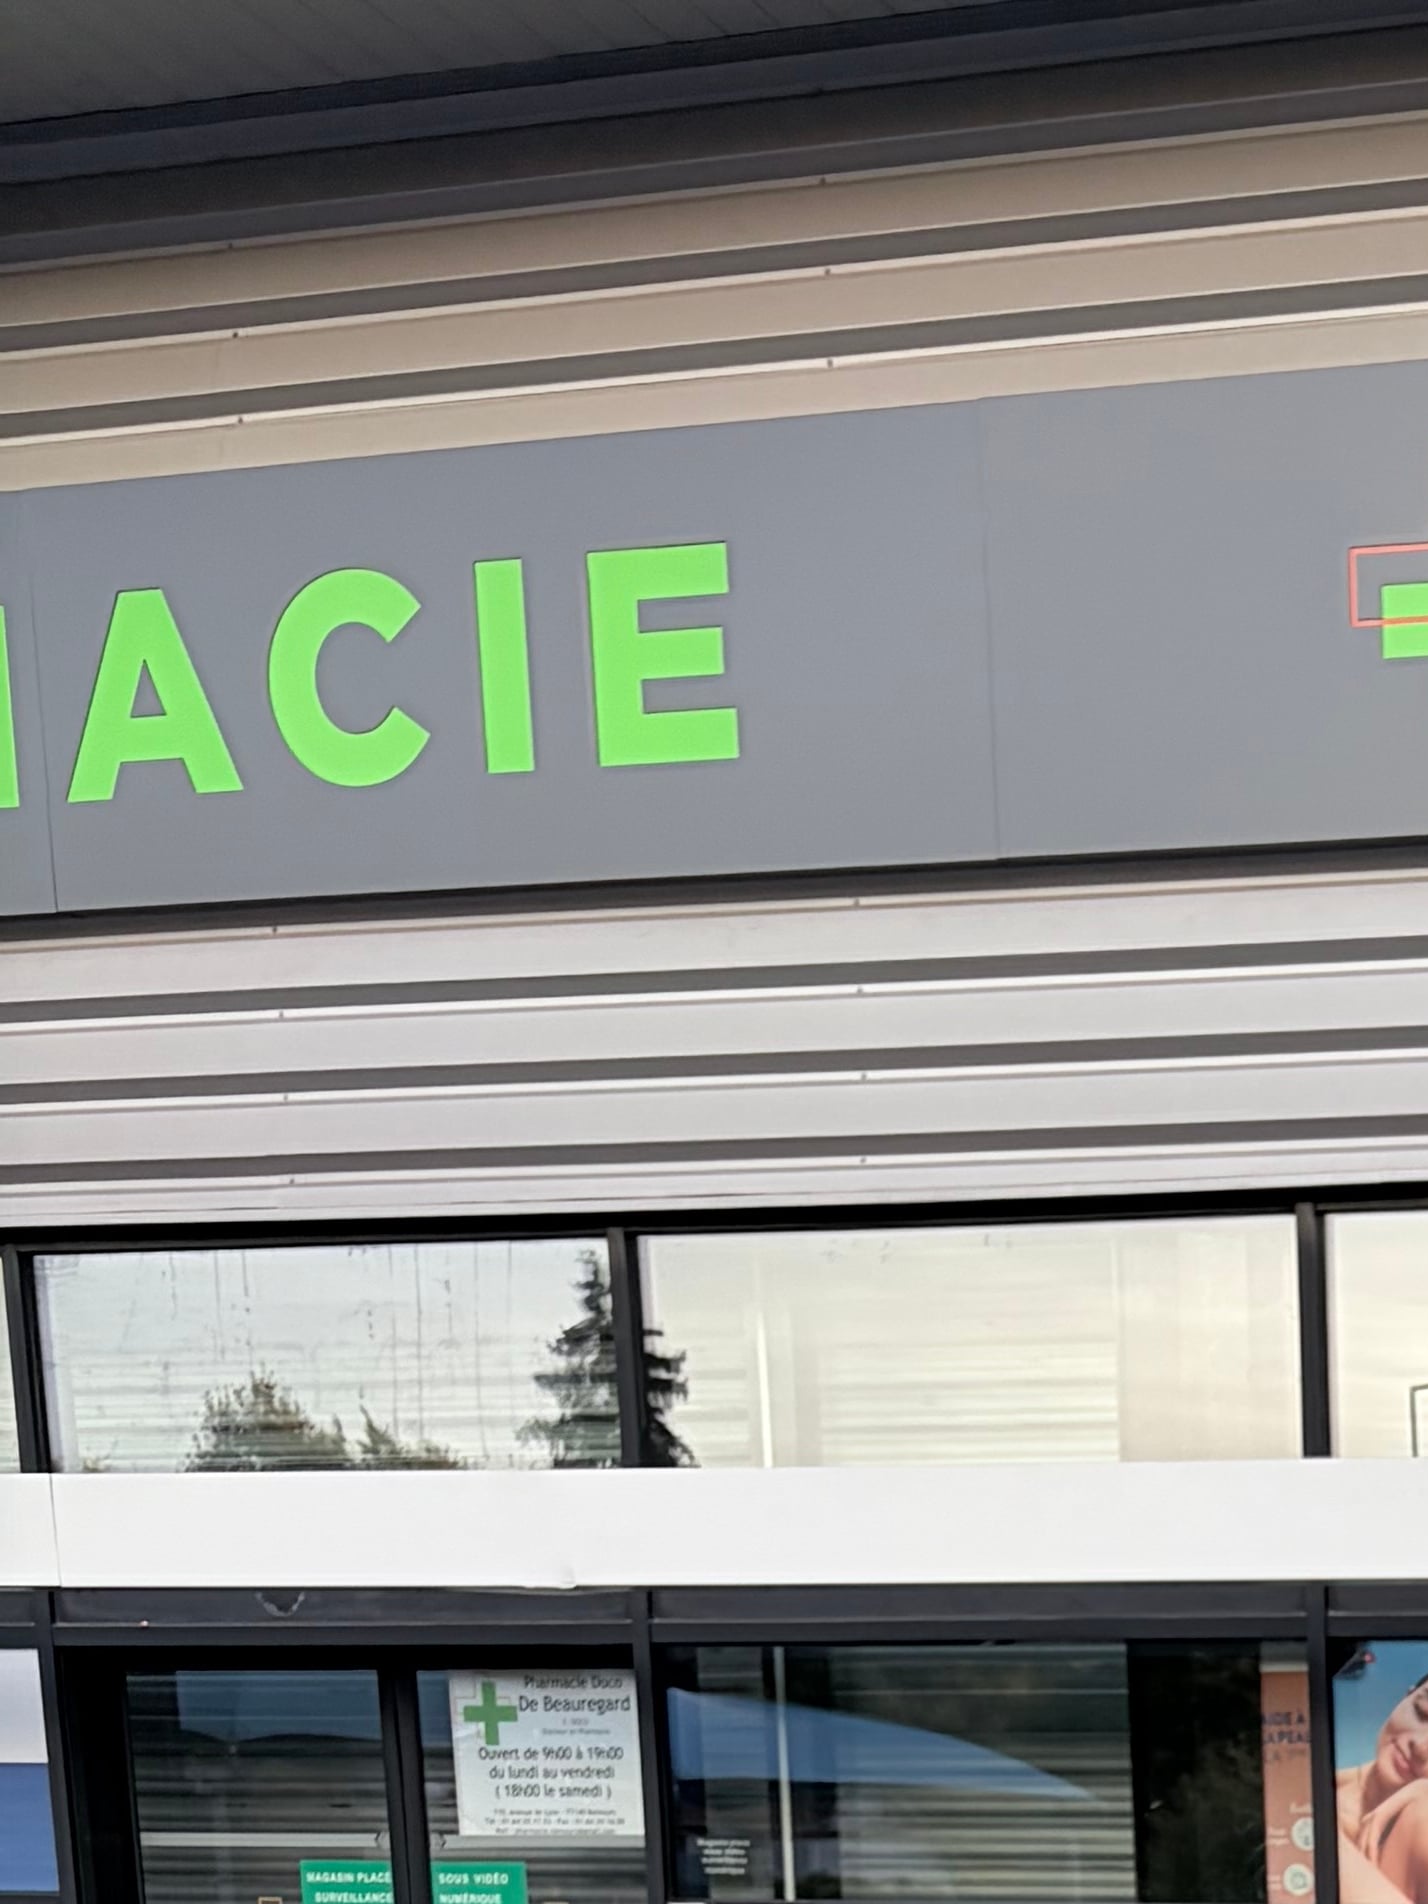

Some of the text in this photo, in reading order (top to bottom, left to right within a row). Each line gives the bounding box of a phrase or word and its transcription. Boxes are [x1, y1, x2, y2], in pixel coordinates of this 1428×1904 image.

[0, 541, 740, 807] ACIE
[523, 1674, 588, 1689] Pharmacie
[519, 1695, 631, 1715] De Beauregard
[478, 1747, 520, 1760] Ouvert
[523, 1747, 540, 1760] de
[489, 1765, 615, 1779] du lundi au vendredi
[544, 1785, 556, 1797] le
[559, 1785, 603, 1798] samedi
[306, 1872, 354, 1883] MAGASIN
[438, 1873, 469, 1884] SOUS
[474, 1871, 509, 1885] VIDÉO
[315, 1892, 503, 1904] SURVEILLANCE NUMÉRIQUE
